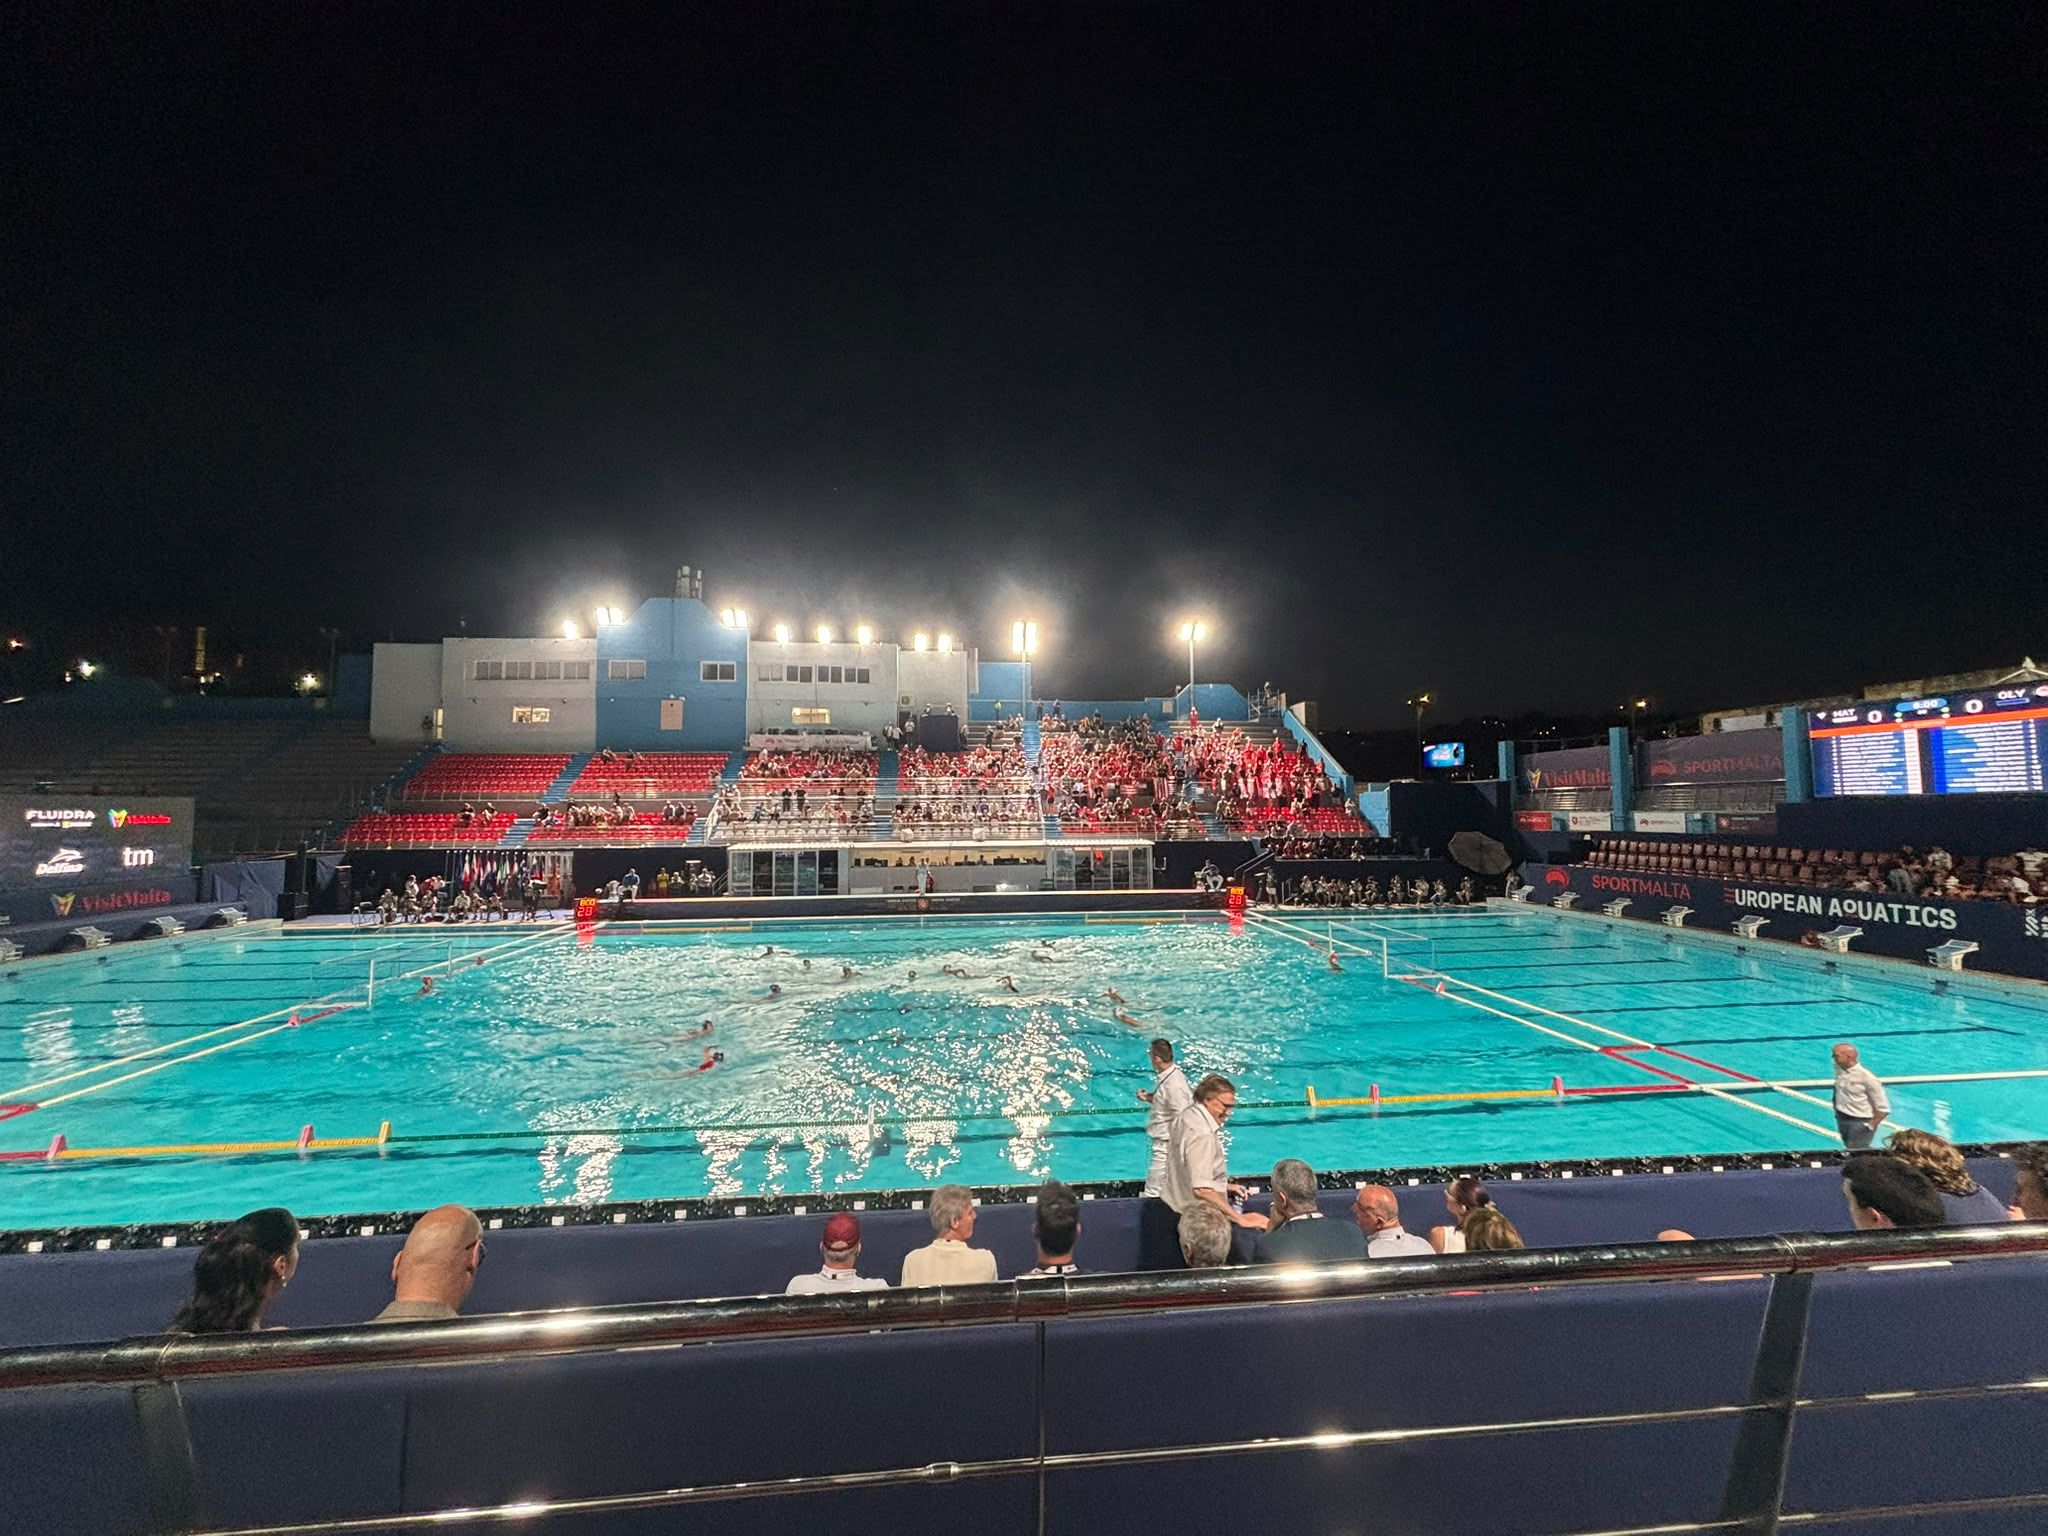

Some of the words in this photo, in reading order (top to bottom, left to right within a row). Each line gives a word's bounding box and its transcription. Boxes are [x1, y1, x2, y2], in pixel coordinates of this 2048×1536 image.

[1998, 688, 2025, 700] OLY
[1966, 699, 1984, 714] 0
[1868, 710, 1883, 724] 0
[25, 809, 96, 821] FLUIDRA
[123, 846, 154, 867] tm
[1592, 875, 1691, 900] SPORTMALTA
[83, 889, 171, 911] VisitMalta
[1228, 896, 1242, 905] 28
[577, 907, 593, 917] 28
[1829, 896, 1958, 930] AQUATICS
